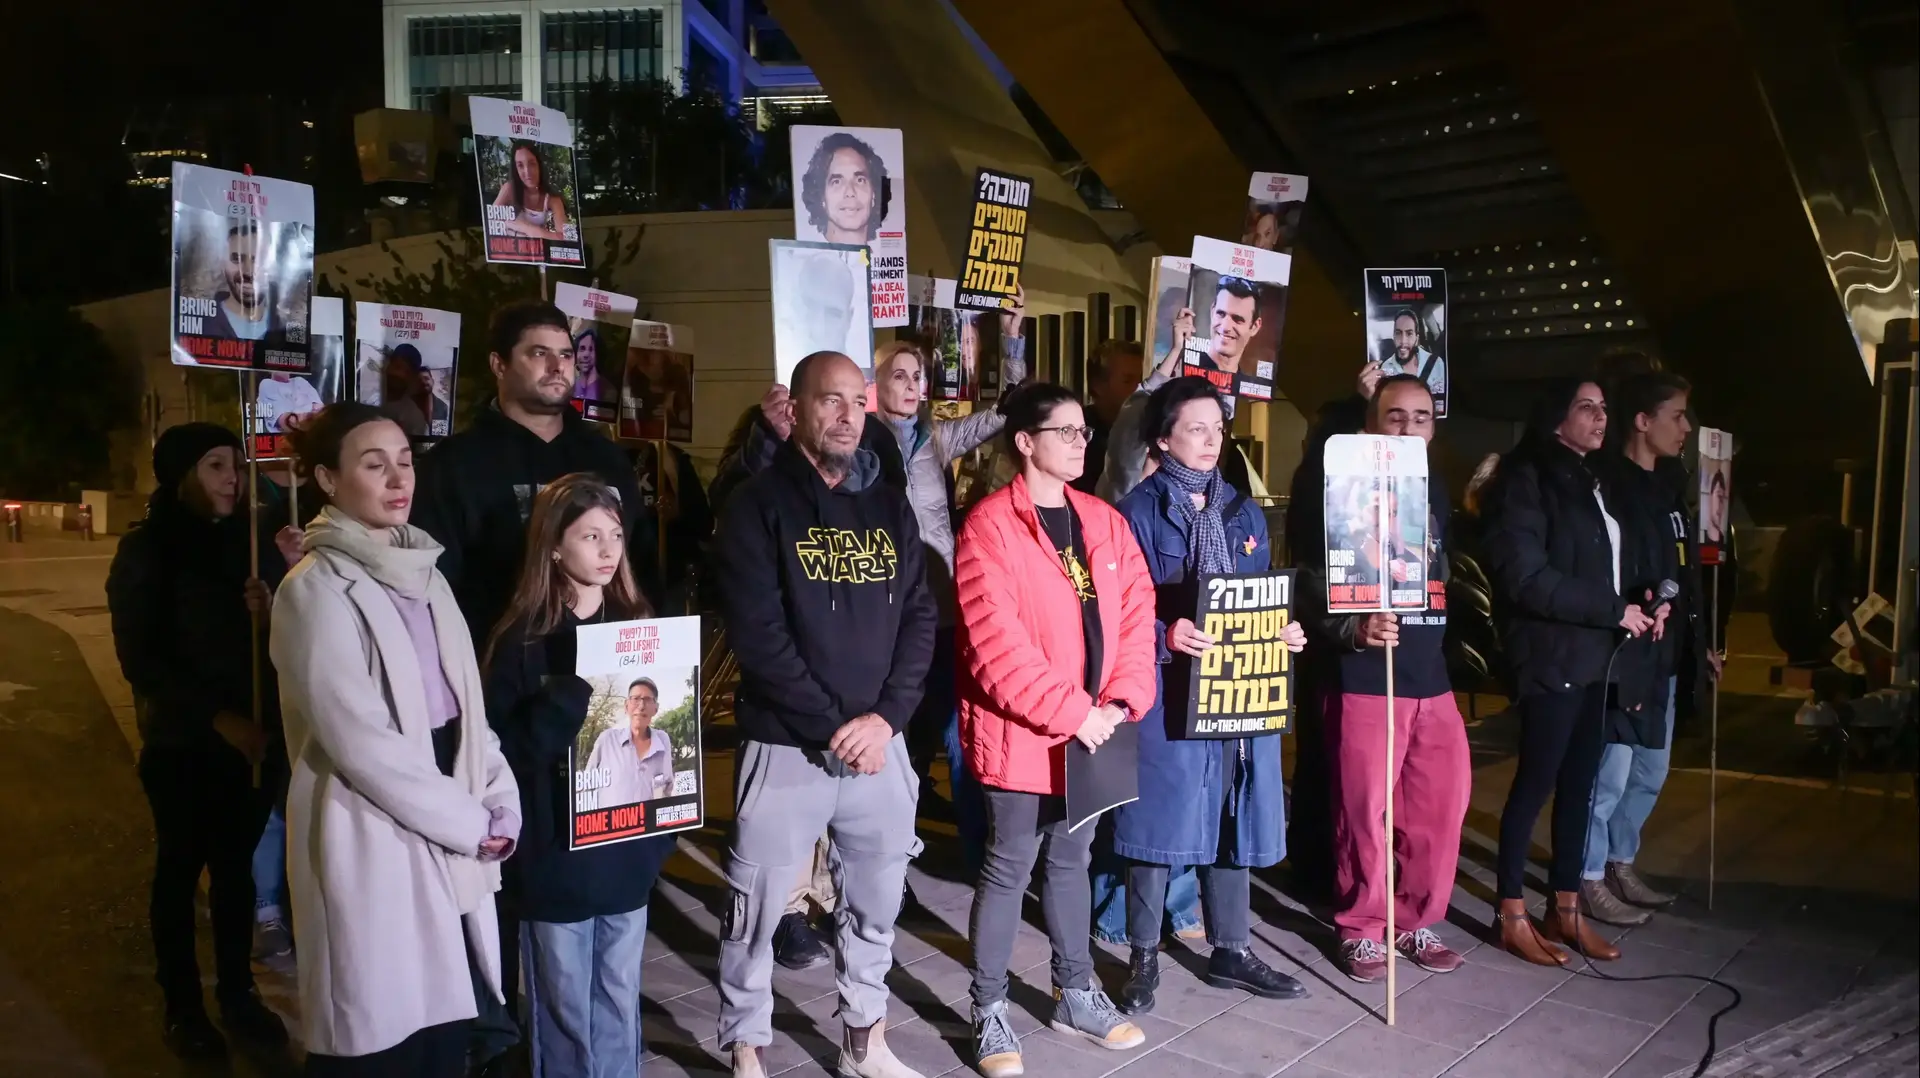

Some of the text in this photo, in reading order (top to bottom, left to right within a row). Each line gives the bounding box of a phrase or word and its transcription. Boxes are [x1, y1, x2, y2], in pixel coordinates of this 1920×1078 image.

[508, 115, 530, 125] NAAMA
[980, 172, 1031, 208] חנוכה?
[486, 204, 516, 221] BRING
[973, 202, 1027, 235] חטופים
[488, 220, 507, 236] HER
[489, 237, 516, 253] HOME
[517, 238, 545, 256] NOW!
[968, 229, 1024, 263] חנוקים
[873, 256, 905, 268] HANDS
[962, 258, 1019, 295] בעזה!
[1380, 275, 1433, 292] מתן עדיין חי
[877, 283, 885, 292] A
[884, 281, 905, 292] DEAL
[179, 295, 217, 318] BRING
[892, 292, 905, 304] MY
[958, 293, 969, 305] ALL
[971, 294, 986, 307] THEM
[985, 296, 1001, 308] HOME
[872, 304, 906, 319] RANT!
[179, 314, 203, 335] HIM
[180, 335, 214, 357] HOME
[217, 339, 255, 359] NOW!
[1183, 348, 1201, 367] HIM
[1207, 370, 1233, 389] NOW!
[796, 528, 896, 557] STAM
[798, 551, 898, 584] WARS
[1329, 549, 1355, 567] BRING
[1329, 566, 1346, 584] HIM
[1207, 575, 1290, 610] חנוכה?
[618, 625, 658, 641] עודד ליפשיץ
[1204, 608, 1288, 642] חטופים
[615, 638, 660, 654] ODED LIFSHITZ
[618, 653, 640, 668] (84)
[1199, 640, 1289, 680] חנוקים
[1197, 676, 1289, 714] בעזה!
[1195, 719, 1213, 733] ALL
[1217, 719, 1242, 732] THEM
[1241, 718, 1266, 731] HOME
[1265, 715, 1287, 730] NOW!
[575, 767, 611, 791] BRING
[575, 789, 599, 813] HIM
[576, 811, 609, 837] HOME
[611, 803, 645, 830] NOW!
